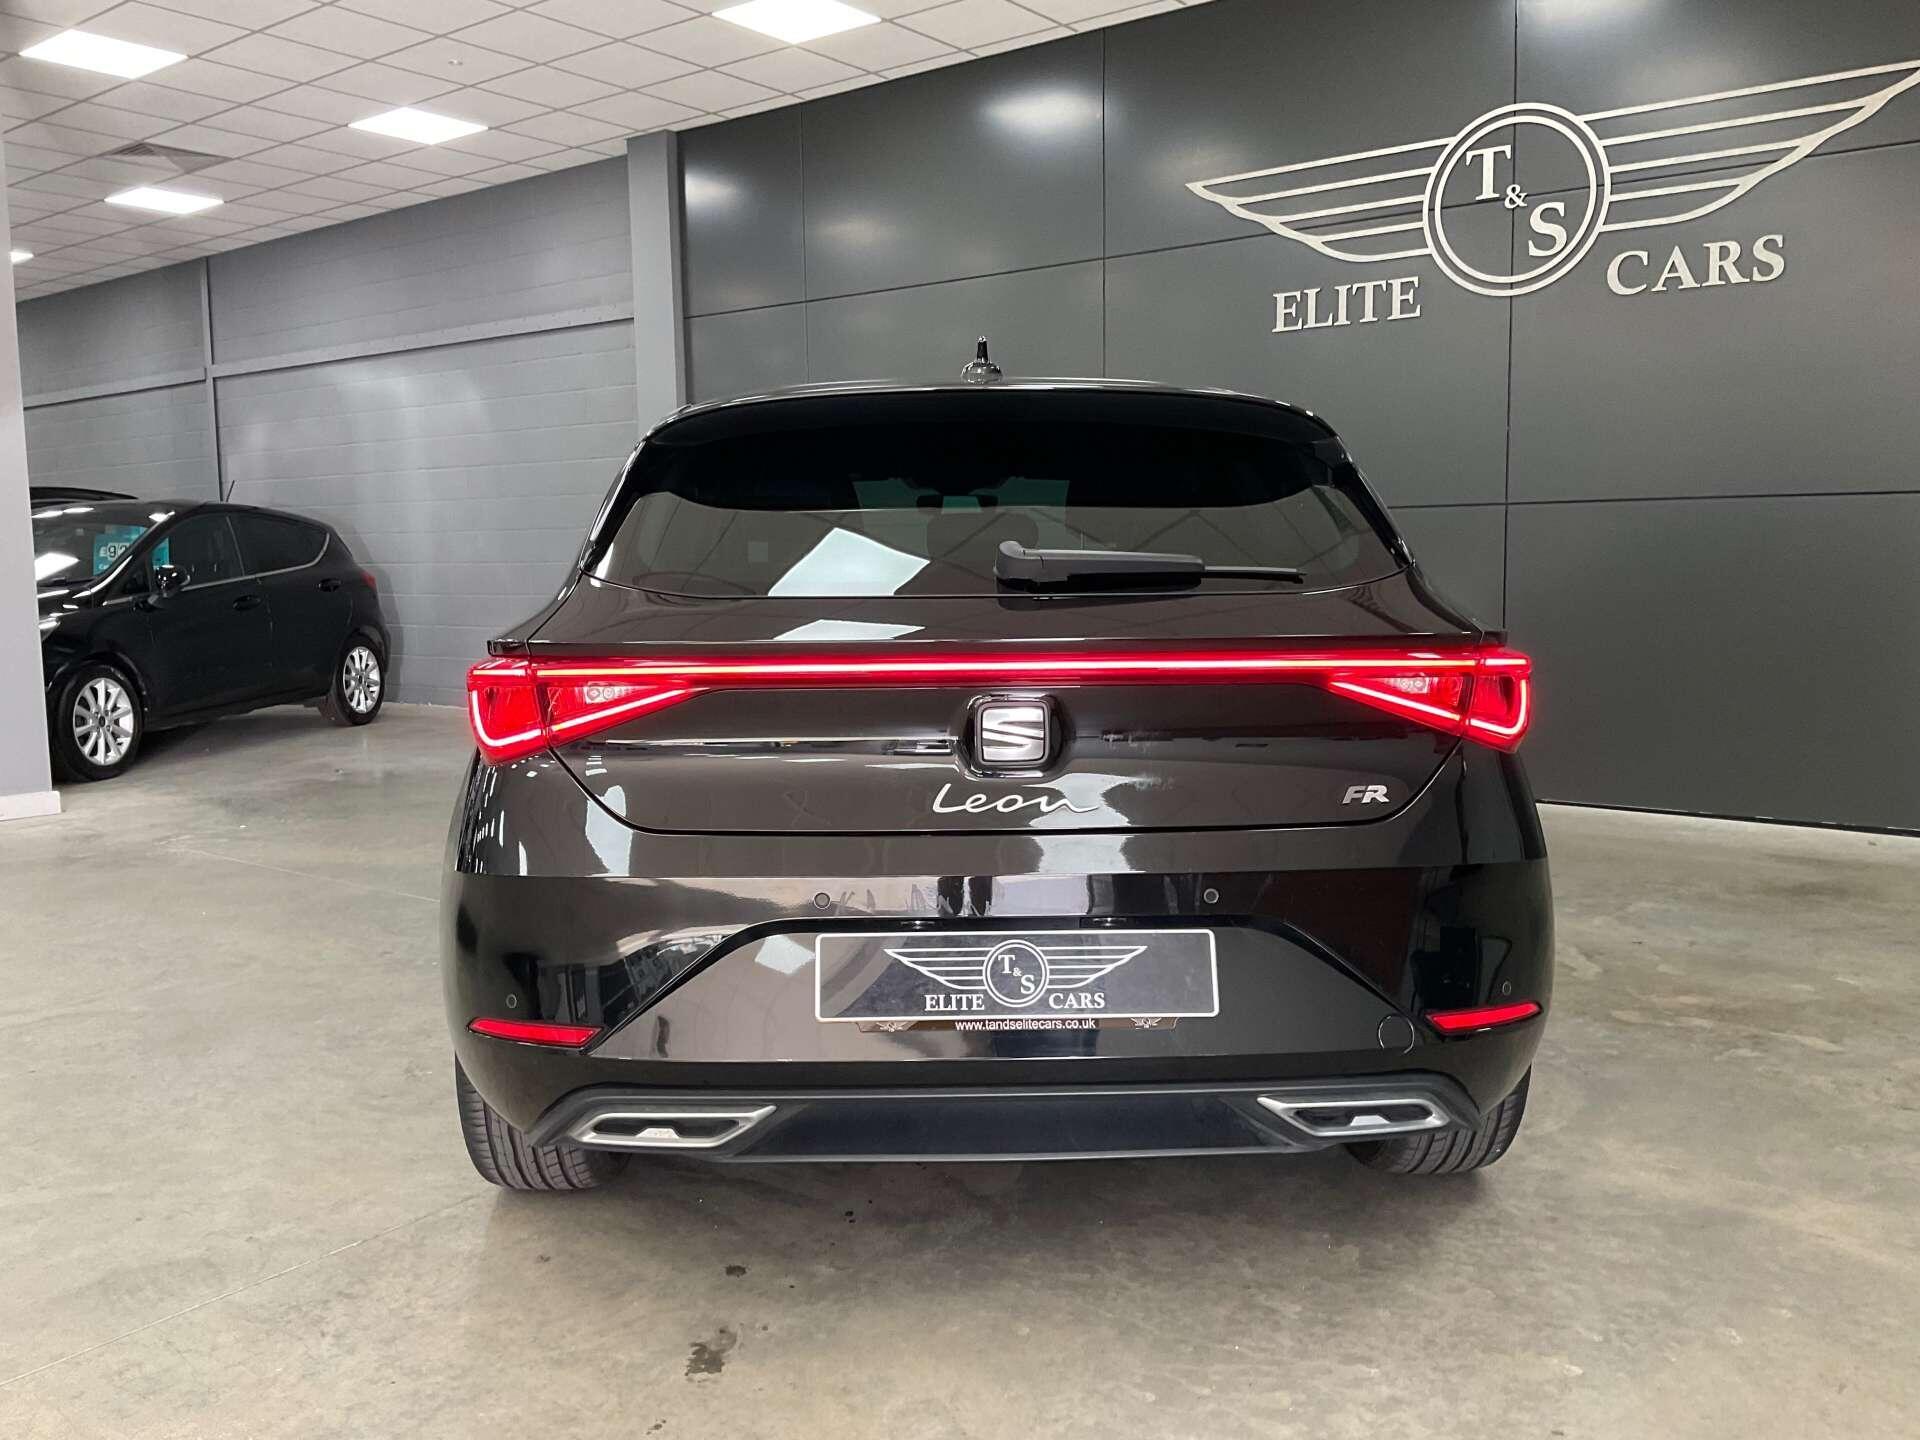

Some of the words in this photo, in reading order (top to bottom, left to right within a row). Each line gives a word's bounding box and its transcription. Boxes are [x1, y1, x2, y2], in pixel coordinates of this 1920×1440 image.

[1271, 276, 1421, 333] ELITE
[1606, 234, 1786, 296] CARS
[932, 783, 1098, 813] Leon
[1341, 785, 1390, 804] FR
[924, 994, 985, 1011] ELITE
[1048, 993, 1105, 1009] CARS
[955, 1018, 1096, 1031] www.tandselitecars.co.uk
